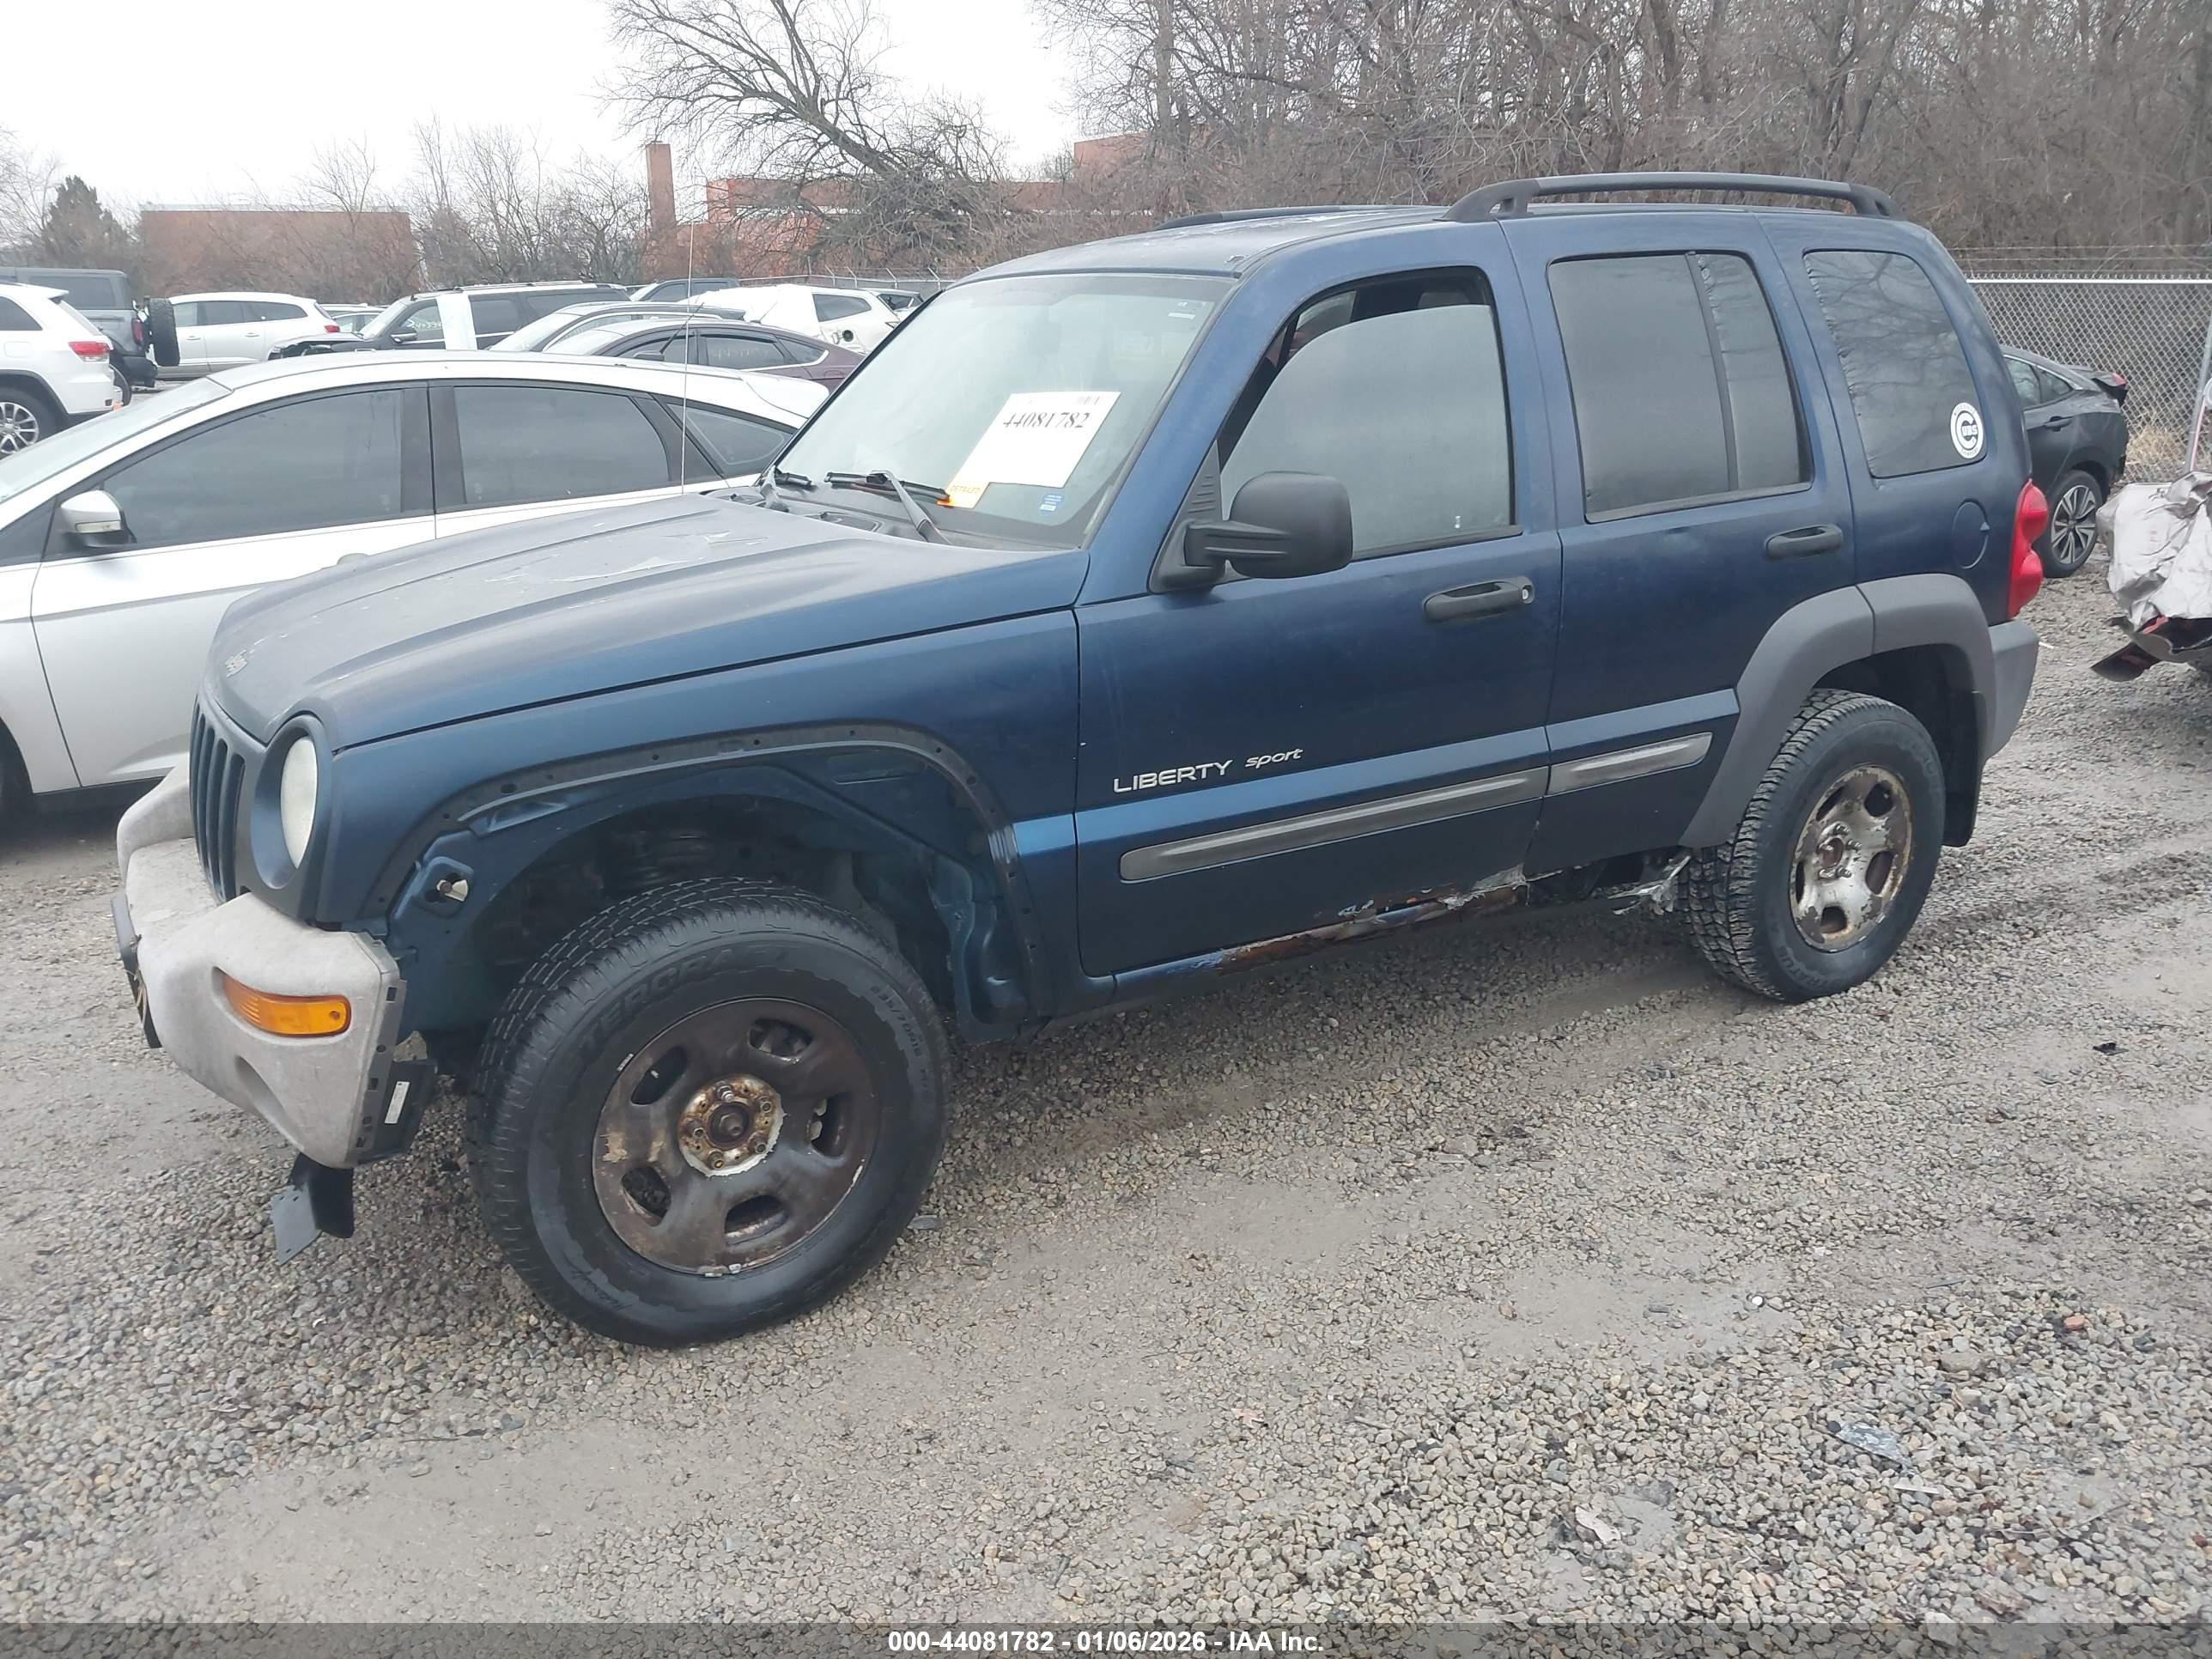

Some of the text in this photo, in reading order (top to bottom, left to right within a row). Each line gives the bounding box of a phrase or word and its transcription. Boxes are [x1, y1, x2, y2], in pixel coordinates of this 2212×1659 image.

[1003, 411, 1091, 428] 44081782
[1114, 748, 1304, 793] LIBERTY sport
